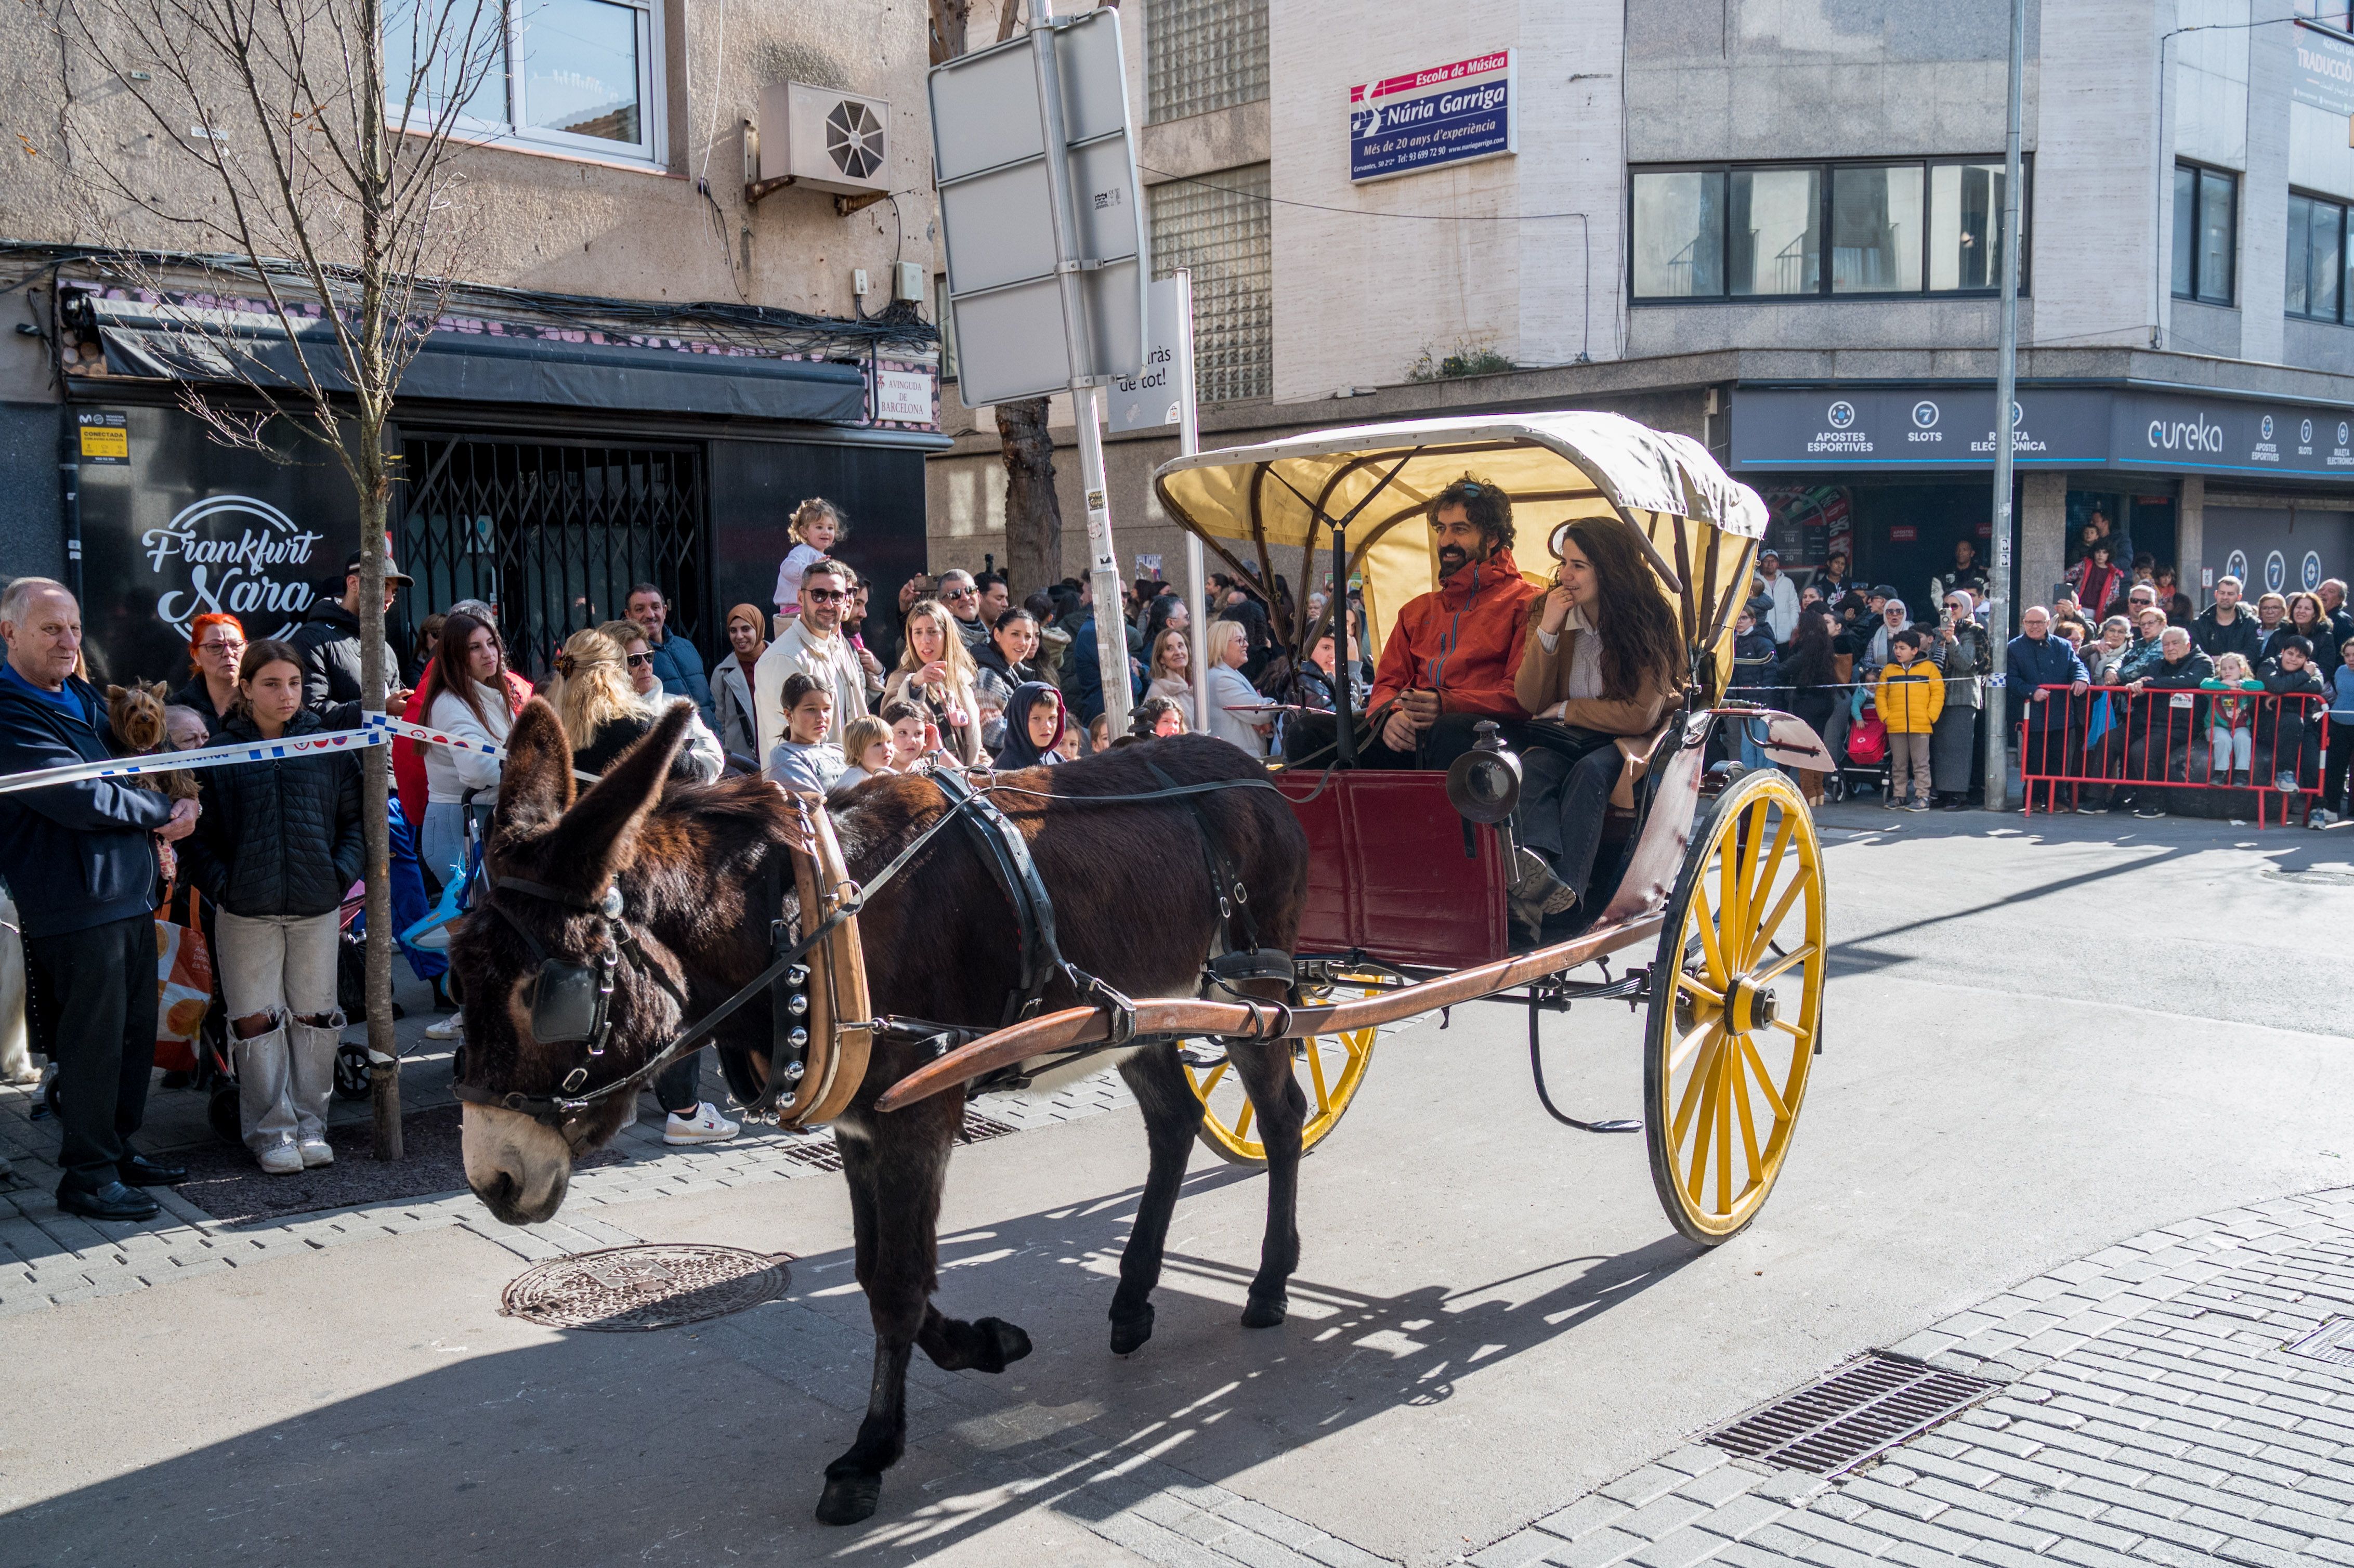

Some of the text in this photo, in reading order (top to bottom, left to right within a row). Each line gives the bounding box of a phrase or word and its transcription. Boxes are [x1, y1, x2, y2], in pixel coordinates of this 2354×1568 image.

[2322, 38, 2344, 54] AGENCIA
[1416, 56, 1504, 86] Escola de Música
[2297, 47, 2352, 83] TRADUCCIÓ
[1387, 86, 1505, 125] Núria Garriga
[1364, 119, 1496, 156] Més de 20 anys d'experiència
[1354, 164, 1377, 173] Cervantes,
[1398, 153, 1408, 163] Tel:
[1409, 152, 1416, 161] 93
[1418, 149, 1429, 159] 699
[1430, 147, 1437, 157] 72
[1438, 146, 1446, 156] 90
[1448, 136, 1505, 153] www.nuriagarriga.com
[1147, 346, 1171, 364] ràs
[1142, 367, 1166, 388] tot!
[889, 380, 922, 390] AVINGUDA
[899, 393, 907, 401] DE
[882, 402, 923, 414] BARCELONA
[1816, 432, 1865, 442] APOSTES
[1908, 432, 1942, 442] SLOTS
[1989, 432, 2030, 441] RTA
[2148, 412, 2222, 452] eureka
[1808, 442, 1873, 452] ESPORTIVES
[1971, 440, 2047, 451] ELECÒNICA
[2256, 442, 2276, 452] APOSTES
[2298, 446, 2312, 455] SLOTS
[2252, 451, 2279, 462] ESPORTIVES
[2334, 448, 2350, 457] RULETA
[142, 528, 323, 576] Frankfurt
[158, 565, 315, 623] Nara
